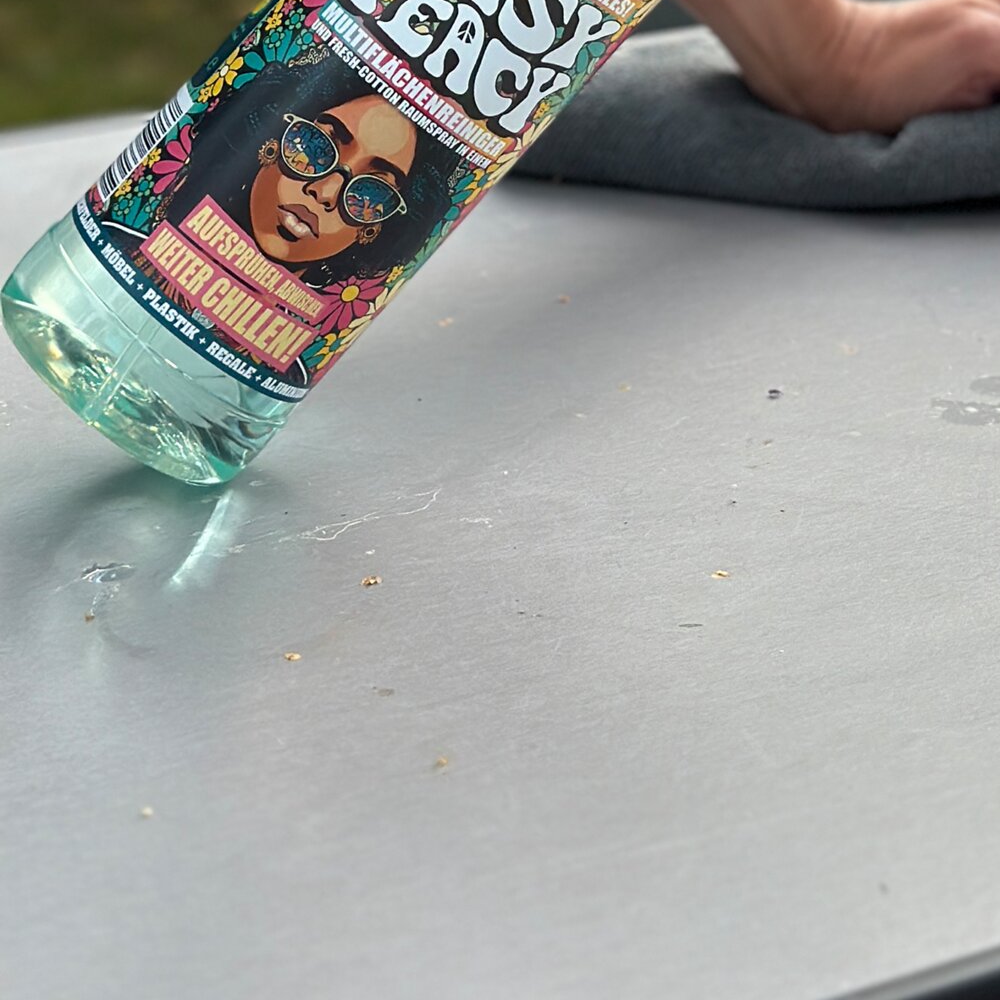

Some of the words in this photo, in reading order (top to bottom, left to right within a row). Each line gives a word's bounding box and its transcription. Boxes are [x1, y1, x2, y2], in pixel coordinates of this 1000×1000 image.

[312, 19, 331, 42] UND
[328, 34, 401, 109] FRESH-COTTON
[397, 100, 459, 150] RAUMSPRAY
[455, 143, 468, 156] IN
[465, 149, 493, 169] EINEM
[321, 0, 507, 158] MULTIFLÄCHENREINIGER
[100, 241, 137, 284] MÖBEL
[142, 289, 203, 340] PLASTIK
[205, 340, 256, 381] REGALE
[147, 227, 214, 296] WEITER
[200, 276, 311, 364] CHILLEN!
[185, 204, 282, 291] AUFSPRÜHEN,
